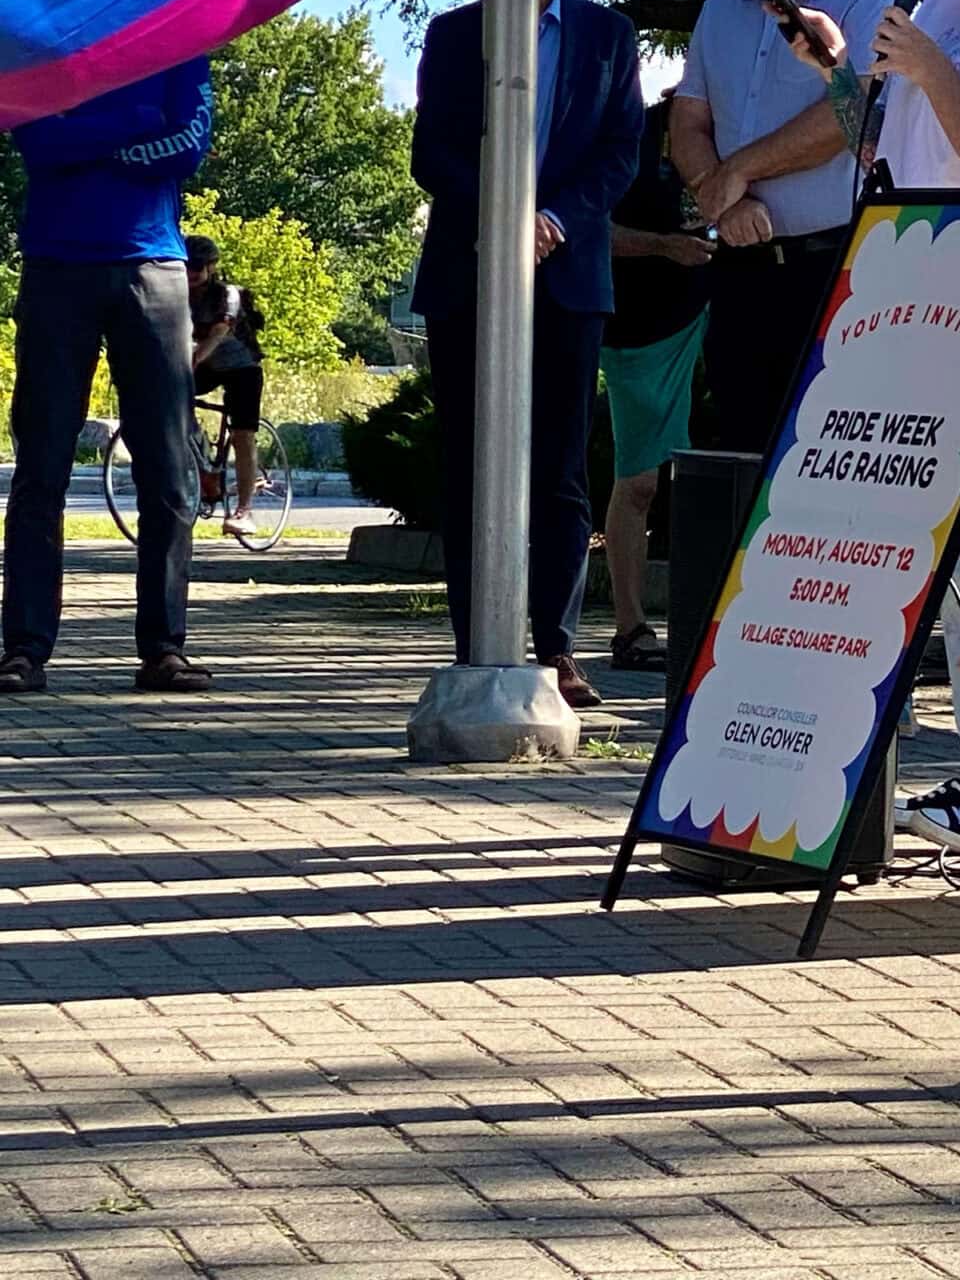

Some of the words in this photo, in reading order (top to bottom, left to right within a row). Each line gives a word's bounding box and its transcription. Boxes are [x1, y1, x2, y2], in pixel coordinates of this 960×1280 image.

[841, 304, 916, 345] YOU'RE
[820, 409, 881, 442] PRIDE
[881, 412, 945, 447] WEEK
[798, 448, 853, 480] FLAG
[851, 451, 938, 488] RAISING
[762, 532, 827, 565] MONDAY,
[828, 539, 896, 569] AUGUST
[895, 546, 915, 572] 12
[788, 577, 819, 602] 5:00
[819, 581, 852, 607] P.M.
[740, 623, 787, 646] VILLAGE
[787, 630, 835, 653] SQUARE
[835, 636, 872, 659] PARK
[724, 720, 760, 745] GLEN
[760, 726, 813, 755] GOWER
